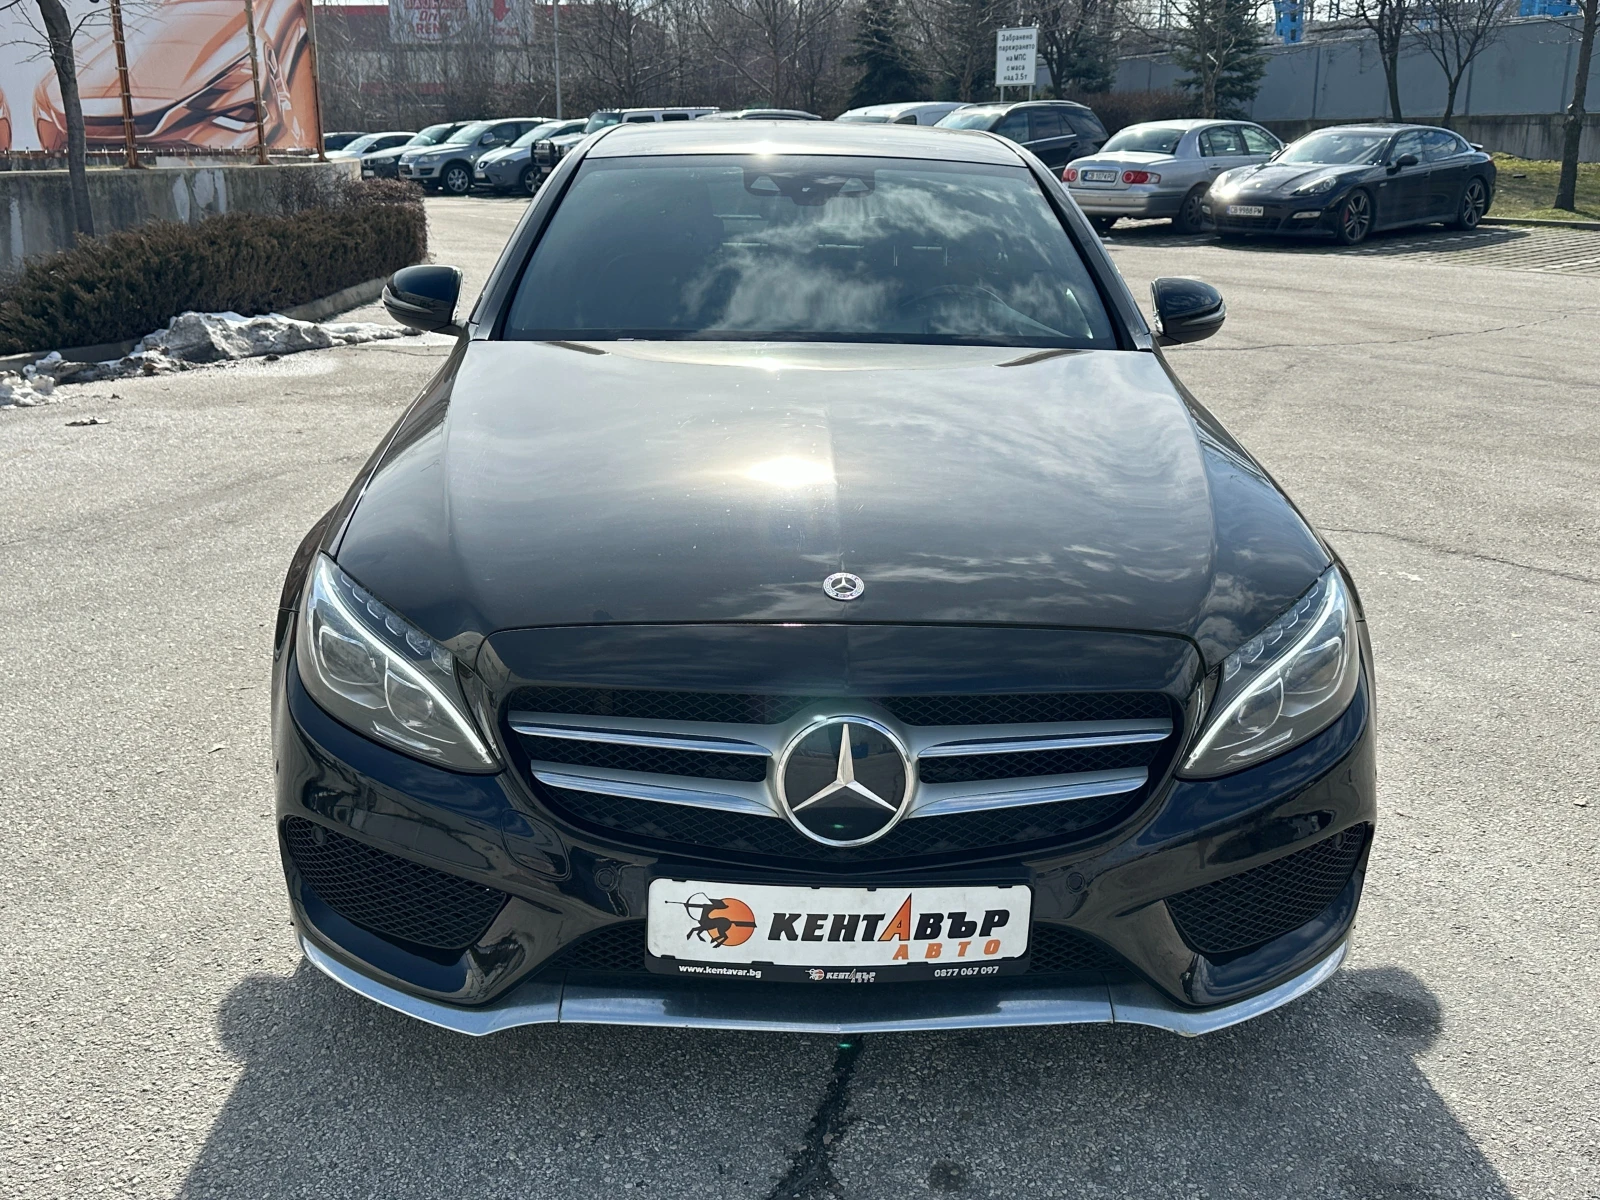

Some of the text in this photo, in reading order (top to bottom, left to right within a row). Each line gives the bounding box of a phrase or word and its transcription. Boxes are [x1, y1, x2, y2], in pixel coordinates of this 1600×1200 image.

[1001, 34, 1033, 42] Забранено
[1013, 53, 1027, 61] МПС
[768, 893, 1010, 942] КЕНТАВЪР
[892, 939, 1001, 961] АВТО
[678, 964, 762, 979] www.kentavar.bg
[934, 966, 999, 977] 0877 067 097
